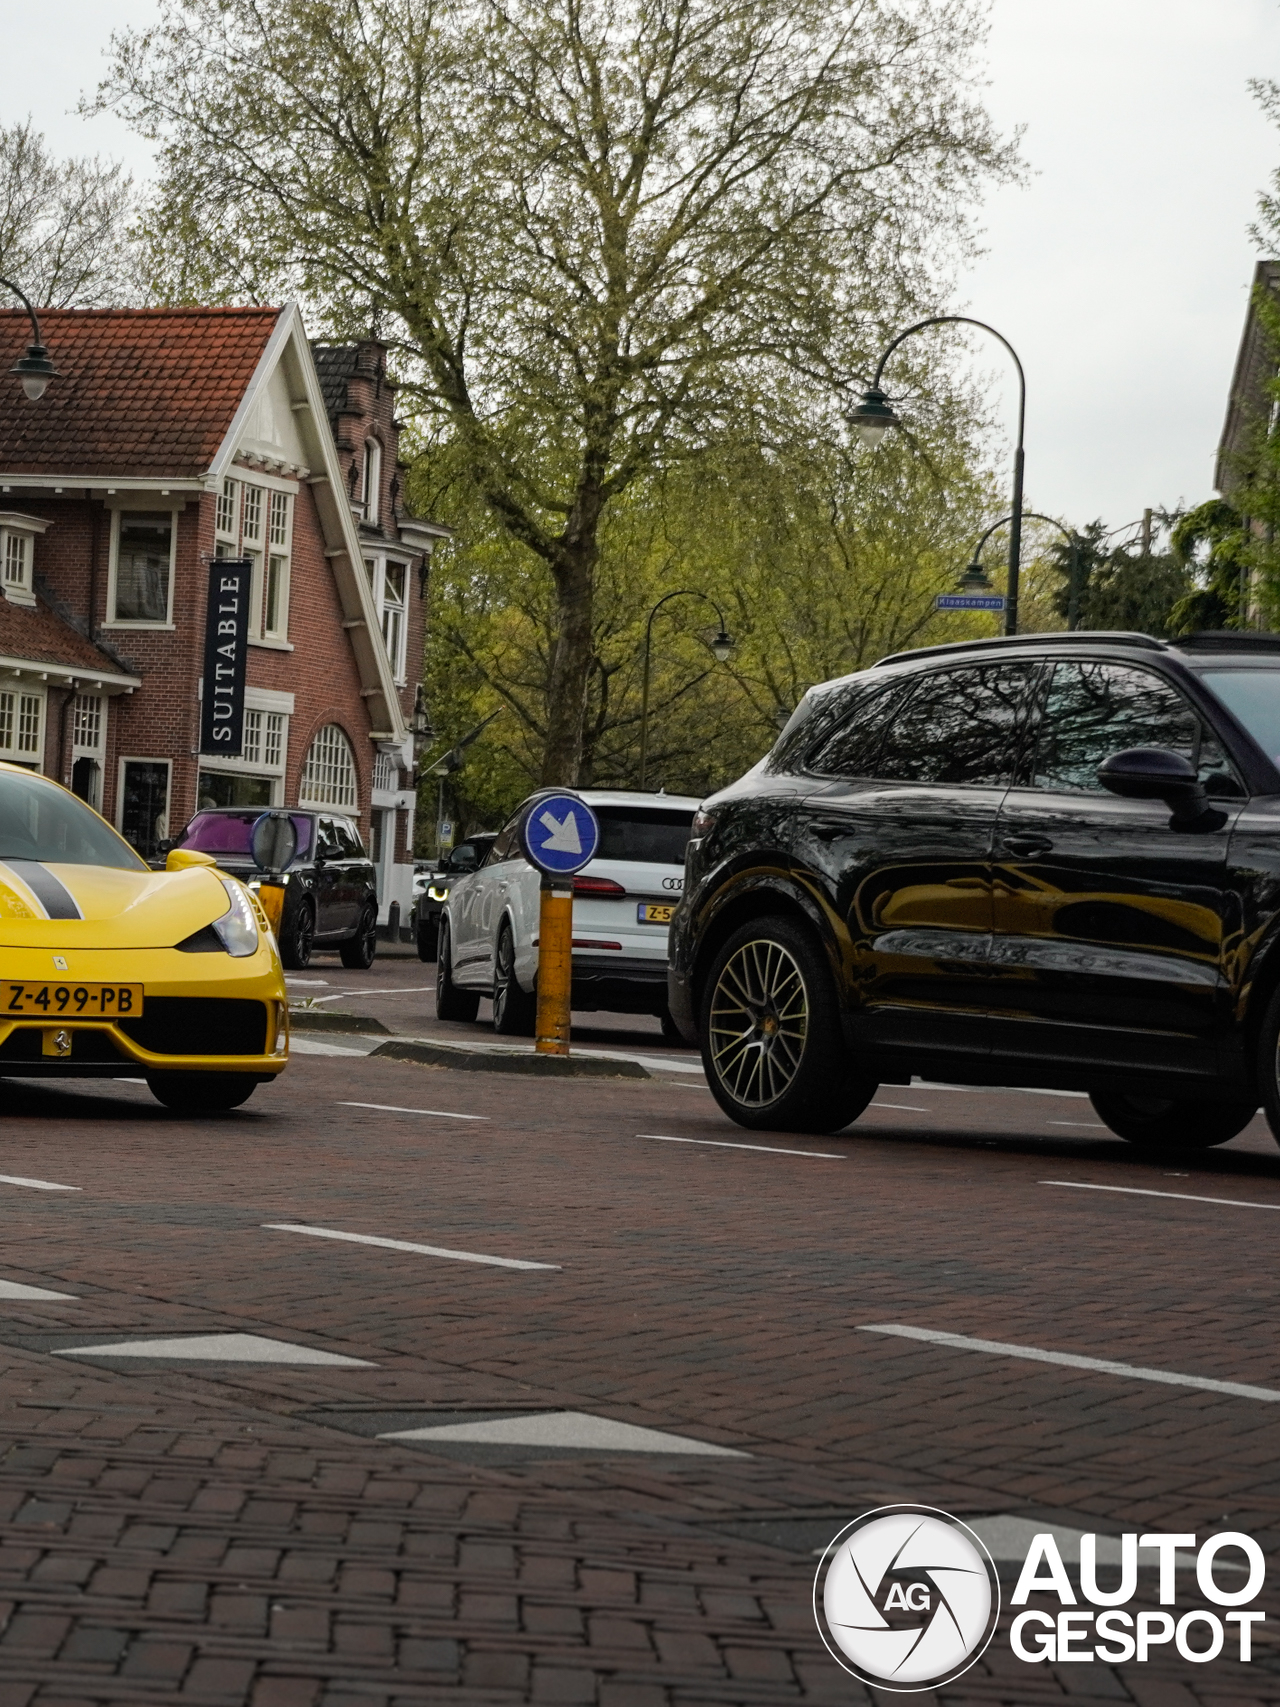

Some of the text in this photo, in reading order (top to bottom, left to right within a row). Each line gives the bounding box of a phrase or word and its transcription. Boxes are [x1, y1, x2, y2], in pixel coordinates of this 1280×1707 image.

[939, 598, 1001, 607] Klaaskampen
[212, 577, 240, 741] SUITABLE
[442, 823, 450, 834] P
[8, 985, 132, 1012] Z-499-PB
